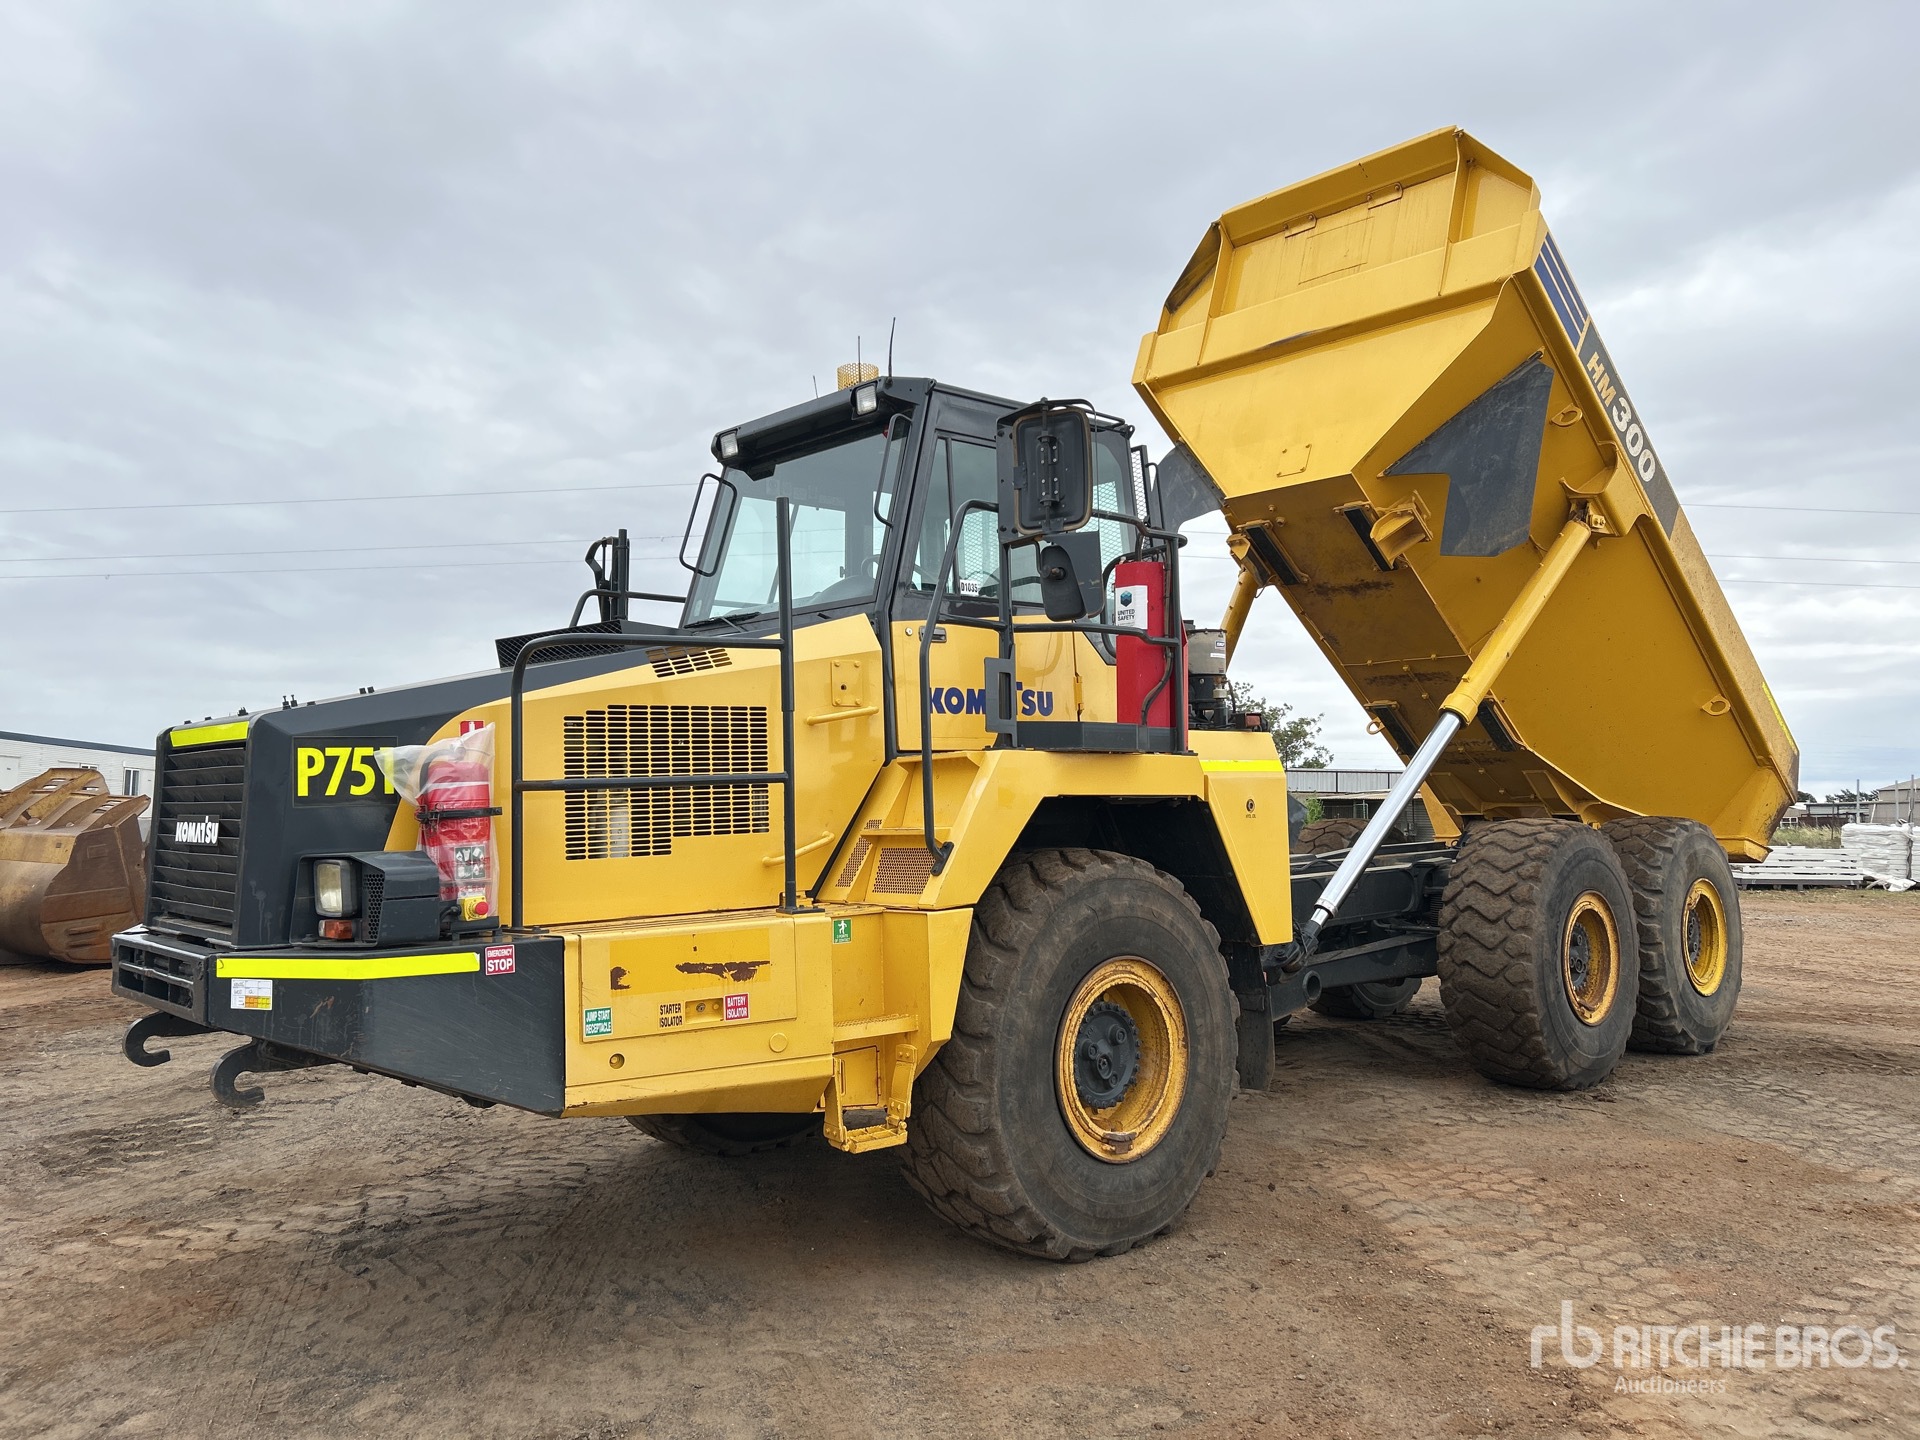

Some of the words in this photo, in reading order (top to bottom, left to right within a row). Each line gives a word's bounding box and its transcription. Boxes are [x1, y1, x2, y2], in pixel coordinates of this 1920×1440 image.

[929, 681, 1054, 717] KOMSU
[297, 746, 395, 797] P751
[175, 815, 219, 844] KOMATSU
[487, 948, 513, 958] EMERGENCY
[487, 958, 513, 972] STOP
[727, 996, 746, 1007] BATTERY
[659, 1003, 681, 1015] STARTER
[727, 1007, 748, 1019] ISOLATOR
[586, 1011, 597, 1022] JUMP
[597, 1009, 610, 1021] START
[585, 1022, 612, 1034] RECEPTACLE
[659, 1016, 683, 1028] ISOLATOR
